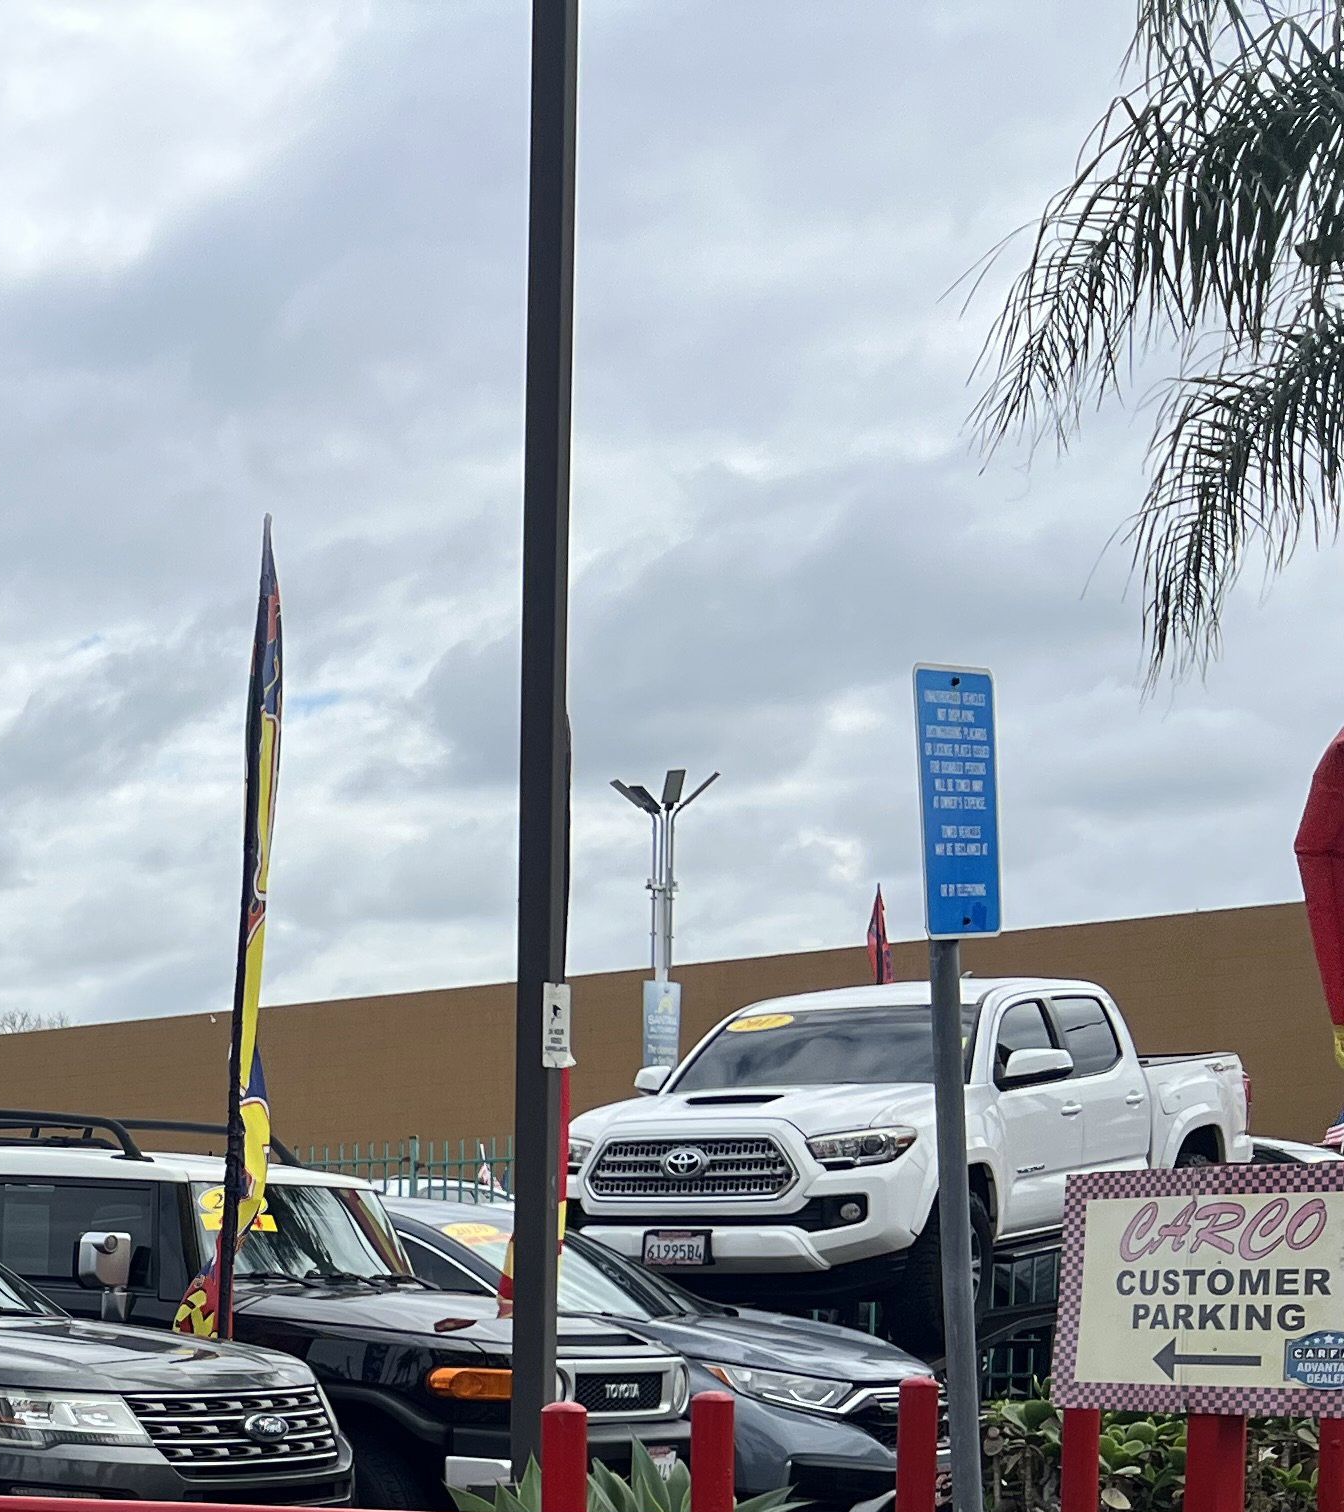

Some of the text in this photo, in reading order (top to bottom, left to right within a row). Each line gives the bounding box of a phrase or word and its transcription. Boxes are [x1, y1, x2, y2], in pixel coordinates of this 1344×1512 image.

[1120, 1197, 1328, 1263] CARCO
[646, 1243, 702, 1260] 61995B4
[1116, 1268, 1331, 1297] CUSTOMER
[1132, 1303, 1306, 1331] PARKING
[1293, 1348, 1344, 1359] CARF
[605, 1383, 640, 1399] TOYOTA
